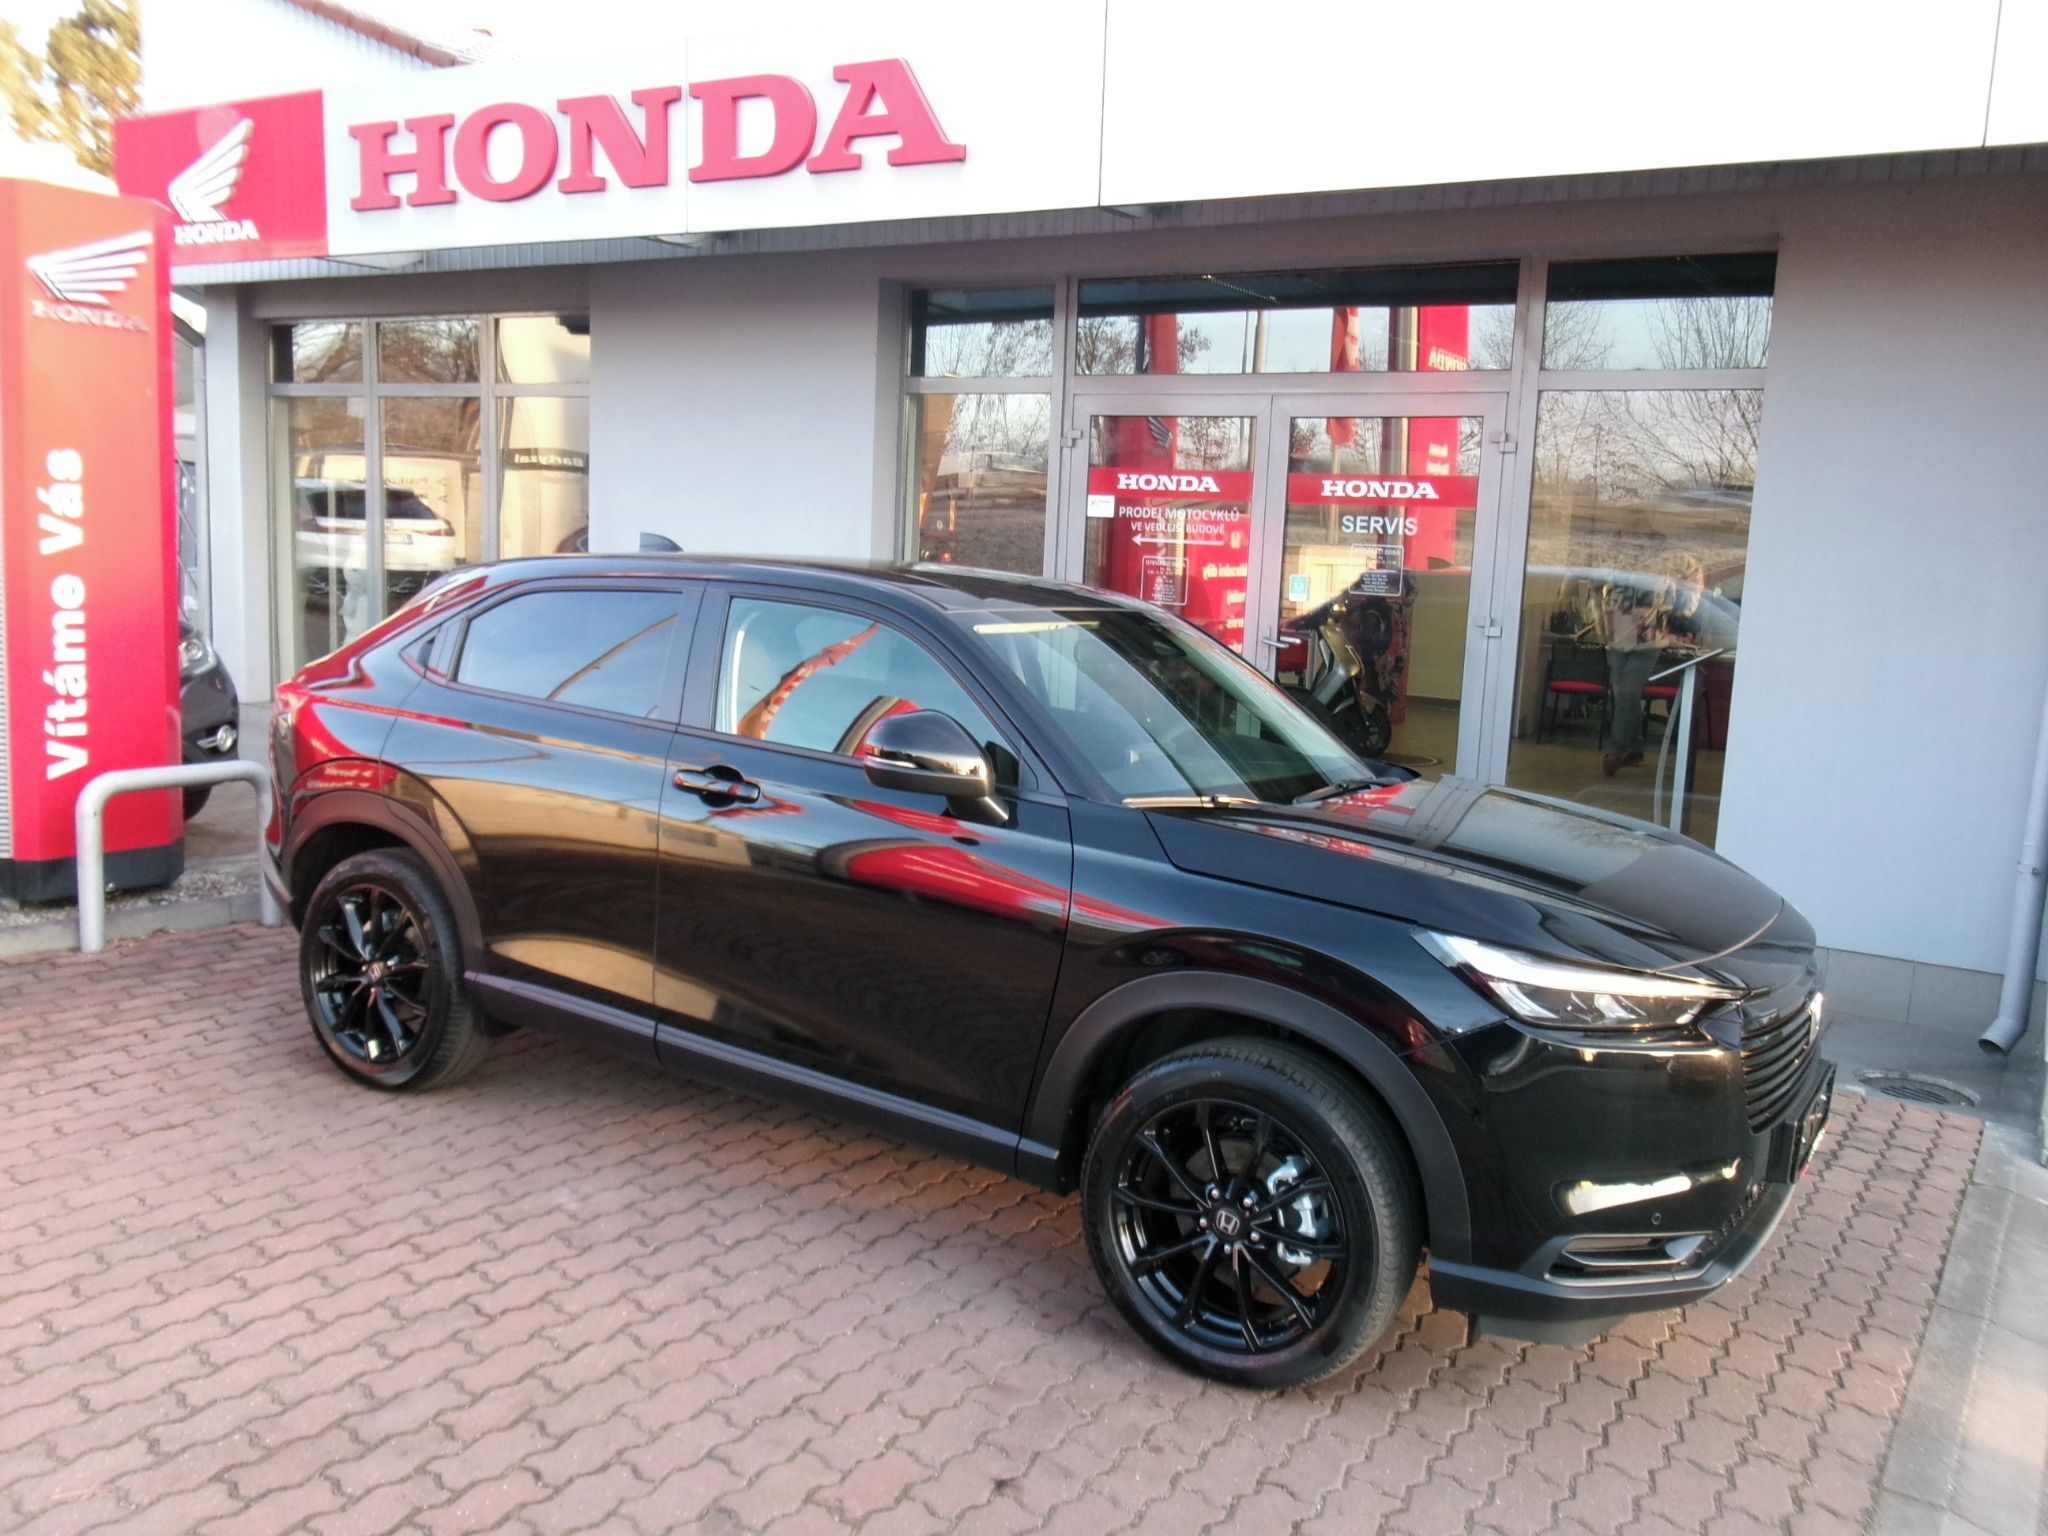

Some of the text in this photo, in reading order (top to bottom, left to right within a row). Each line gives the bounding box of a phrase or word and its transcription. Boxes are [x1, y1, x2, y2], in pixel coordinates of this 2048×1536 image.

[348, 57, 967, 212] HONDA
[174, 219, 258, 245] HONDA
[31, 299, 149, 332] HONDA
[1116, 473, 1221, 492] HONDA
[1320, 479, 1439, 499] HONDA
[1119, 506, 1239, 522] PRODEJ MOTOCYKLŮ
[1131, 521, 1143, 531] VE
[1186, 523, 1224, 534] BUDOVĚ
[1341, 515, 1417, 536] SERVIS
[36, 447, 91, 780] Vítáme Vás
